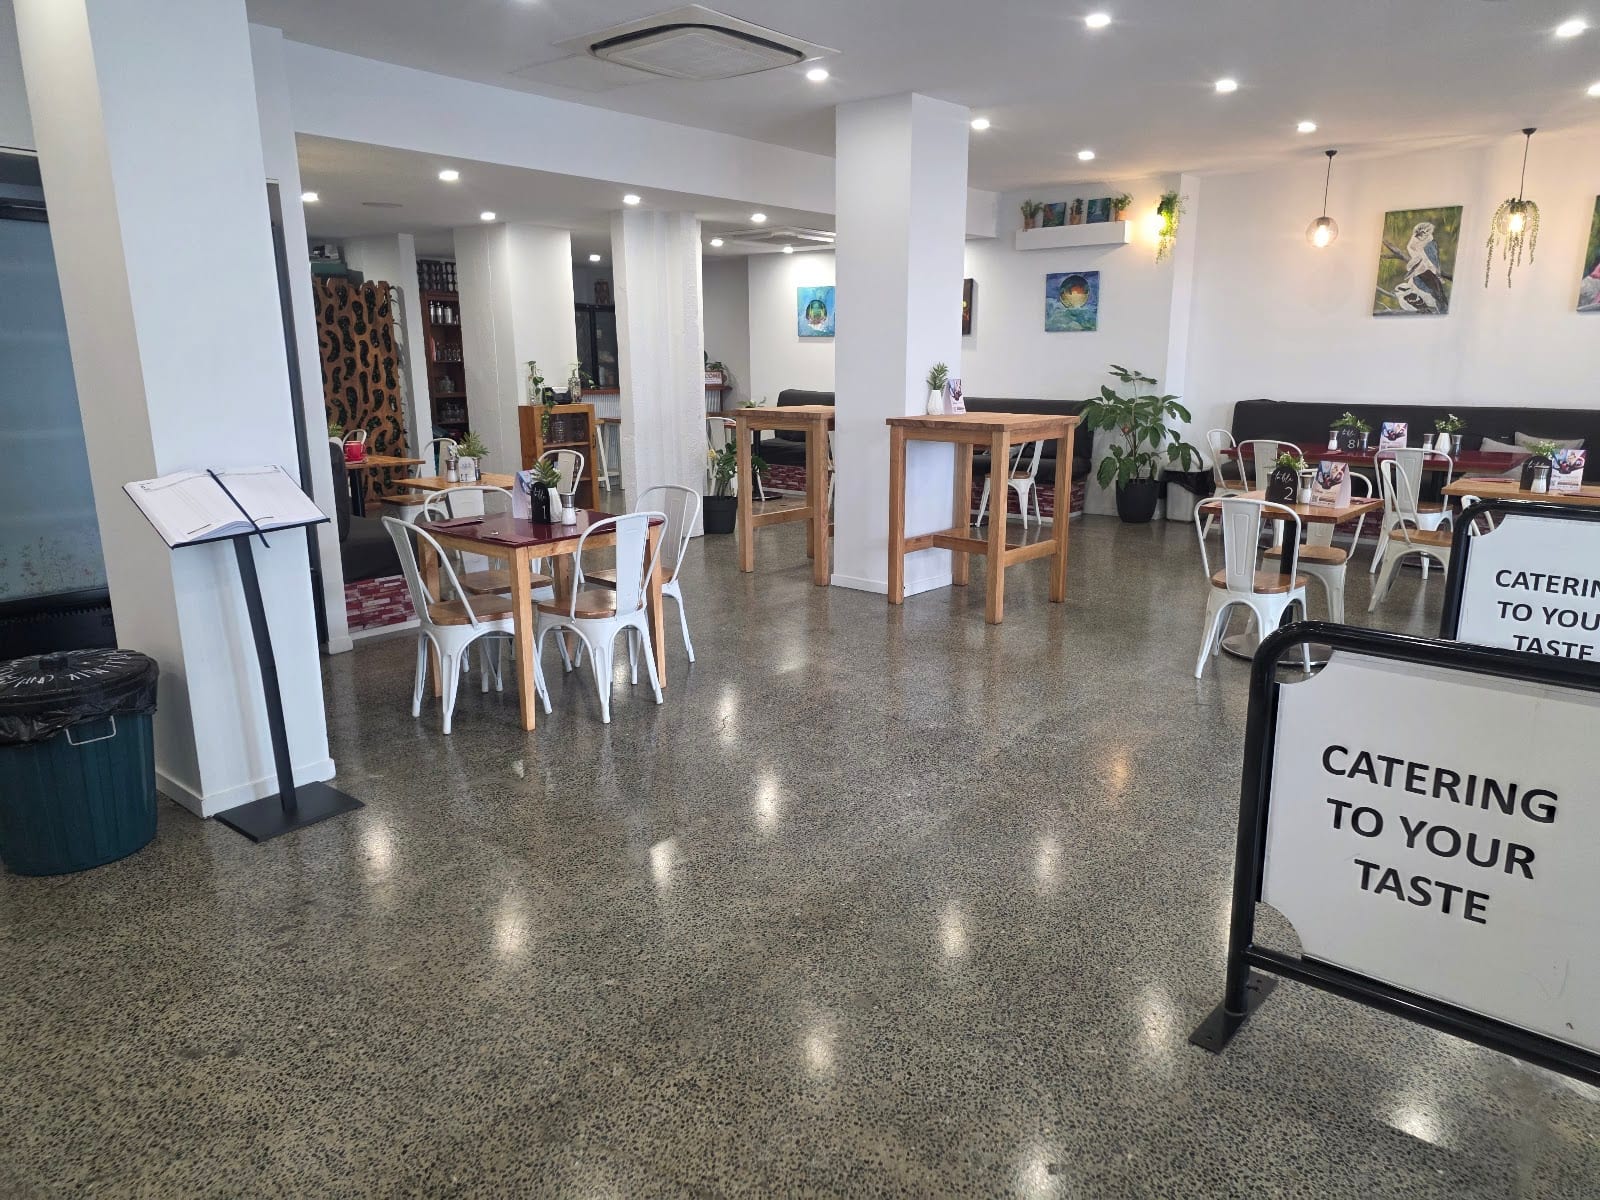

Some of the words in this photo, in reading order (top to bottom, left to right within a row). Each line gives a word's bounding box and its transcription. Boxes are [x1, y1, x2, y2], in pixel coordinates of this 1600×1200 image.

[1347, 440, 1355, 449] 8
[1284, 486, 1294, 500] 2
[1497, 600, 1533, 622] TO
[1542, 606, 1600, 631] YOU
[1322, 744, 1558, 823] CATERING
[1326, 797, 1384, 838] TO
[1399, 815, 1535, 880] YOUR
[1354, 858, 1490, 924] TASTE
